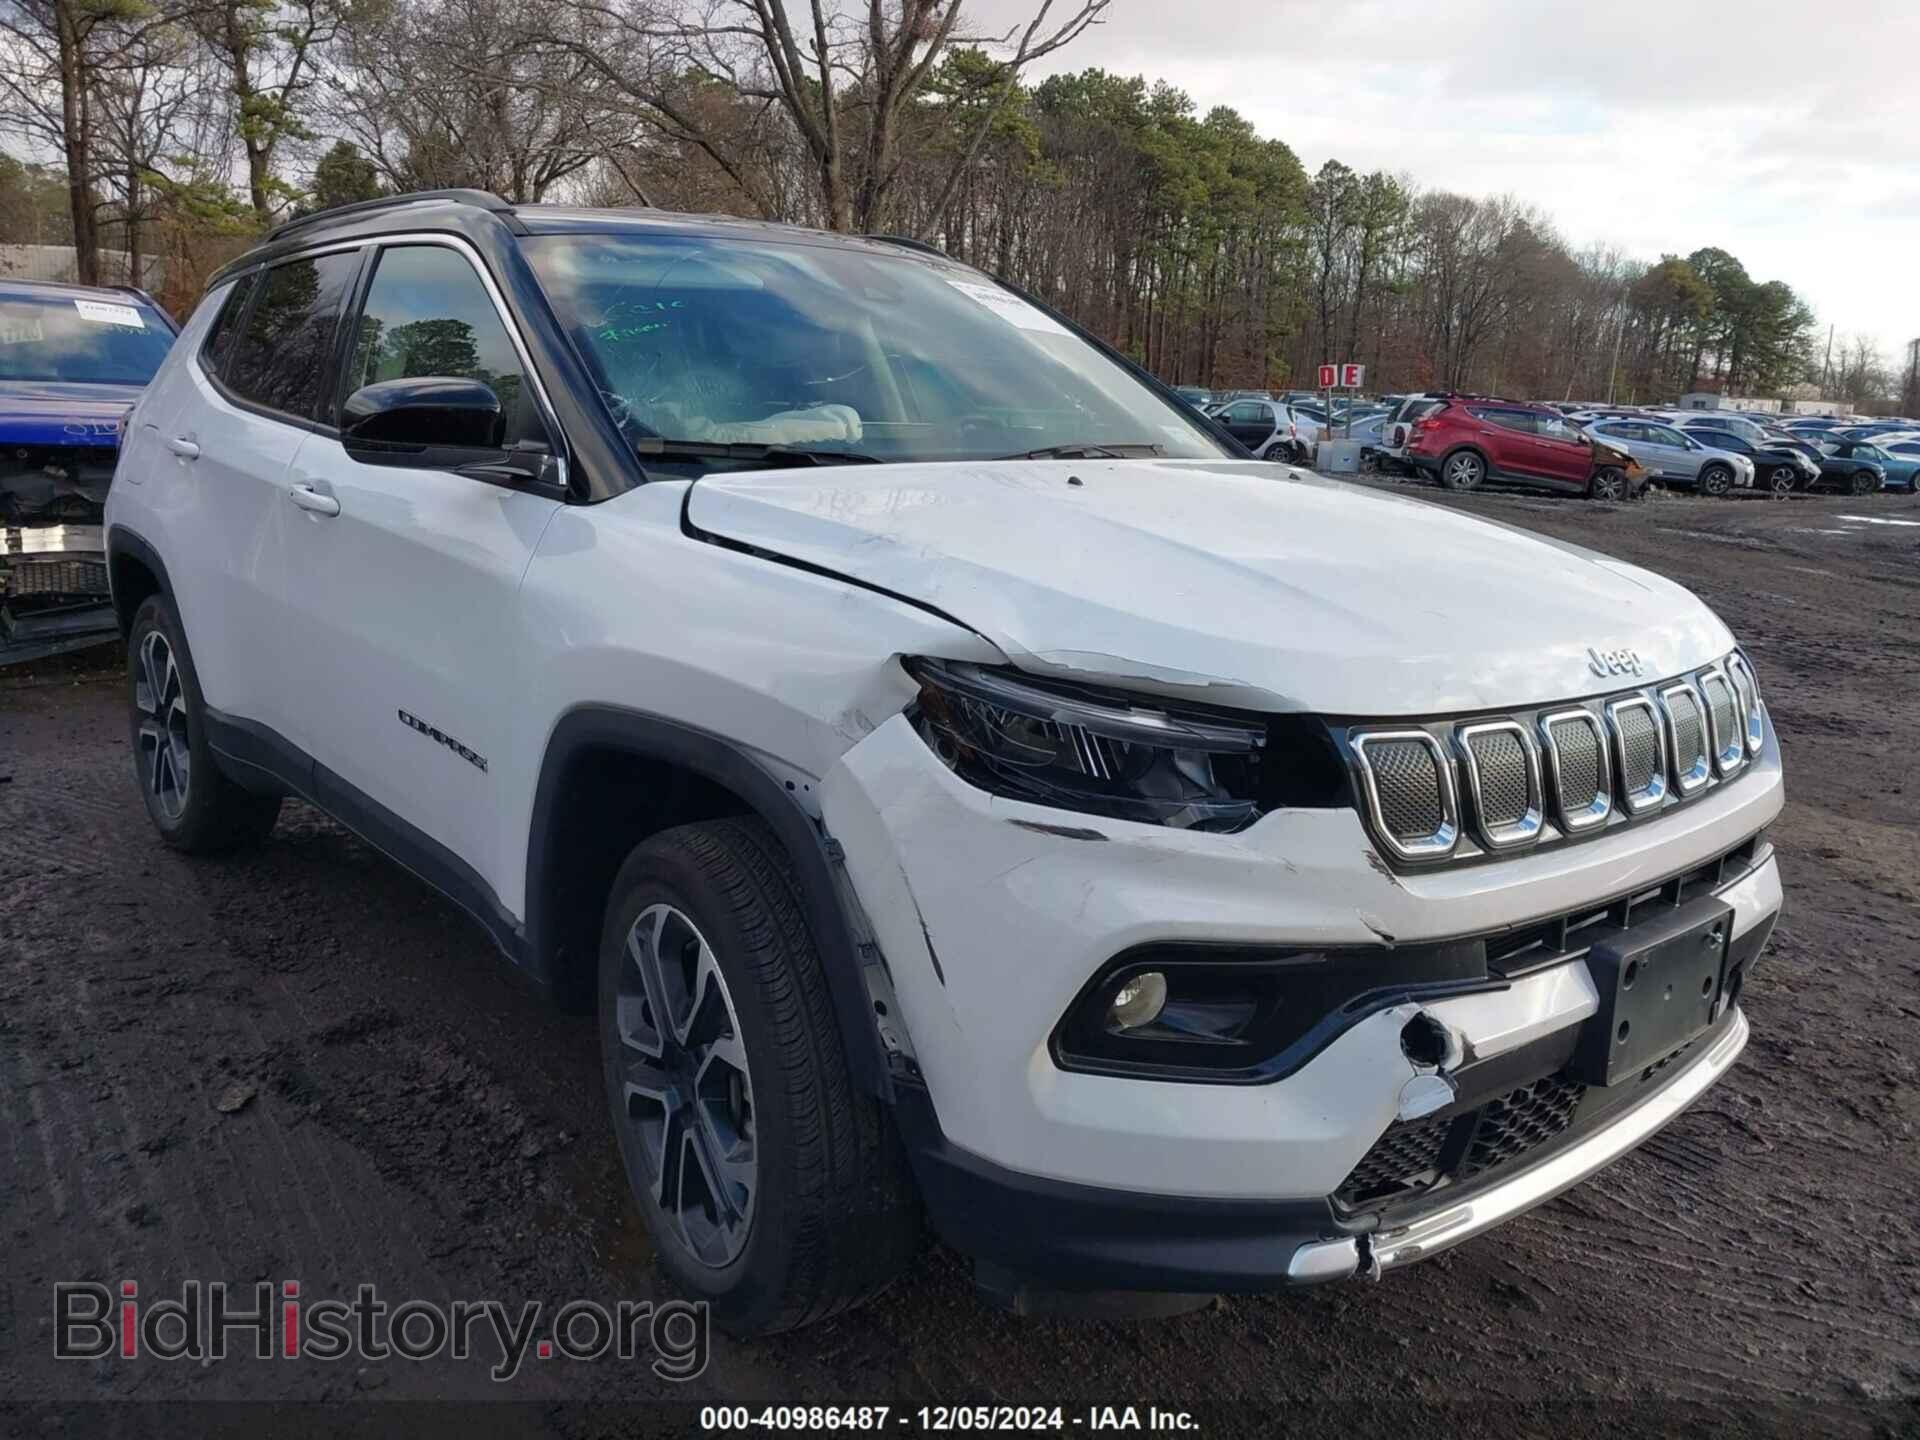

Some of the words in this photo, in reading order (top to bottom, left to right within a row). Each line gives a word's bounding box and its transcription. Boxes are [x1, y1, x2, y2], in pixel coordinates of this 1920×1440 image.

[1344, 366, 1358, 385] E
[1587, 647, 1642, 679] Jeep
[398, 708, 489, 774] COMPASS
